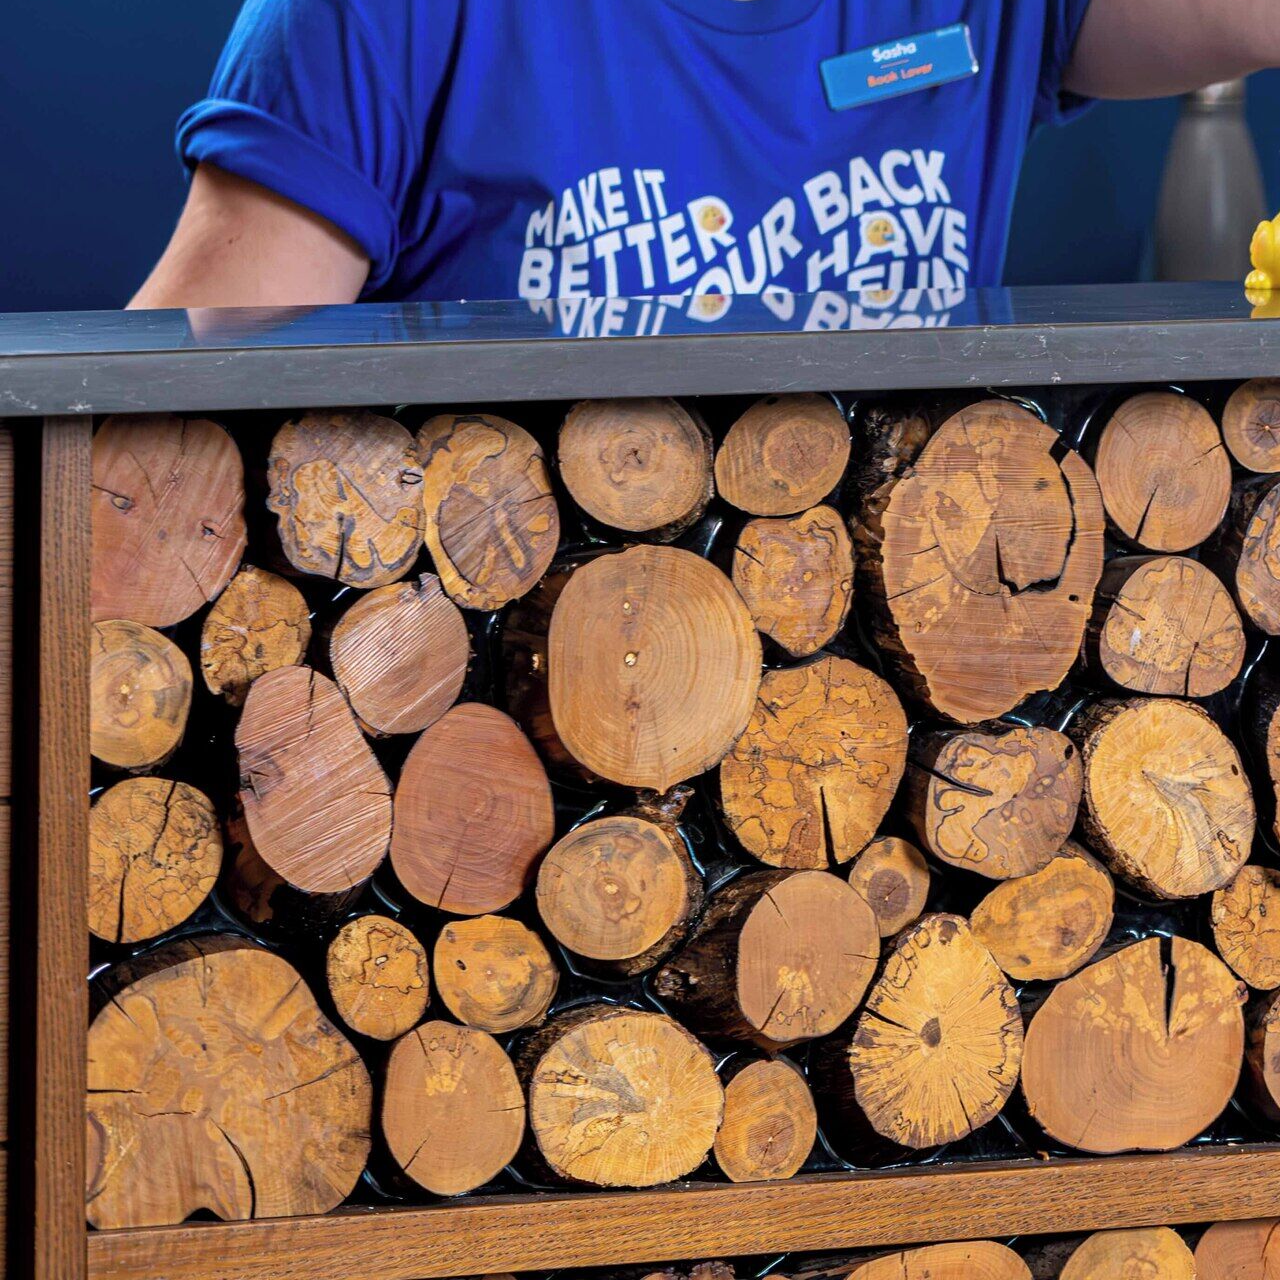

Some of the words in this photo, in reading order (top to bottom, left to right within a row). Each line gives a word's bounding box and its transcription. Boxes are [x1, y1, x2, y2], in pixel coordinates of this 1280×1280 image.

[872, 42, 917, 63] Sasha
[525, 167, 629, 248] MAKE
[633, 168, 668, 221] IT
[803, 148, 951, 235] BACK
[518, 195, 737, 300] BETTER
[807, 206, 969, 293] HAVE
